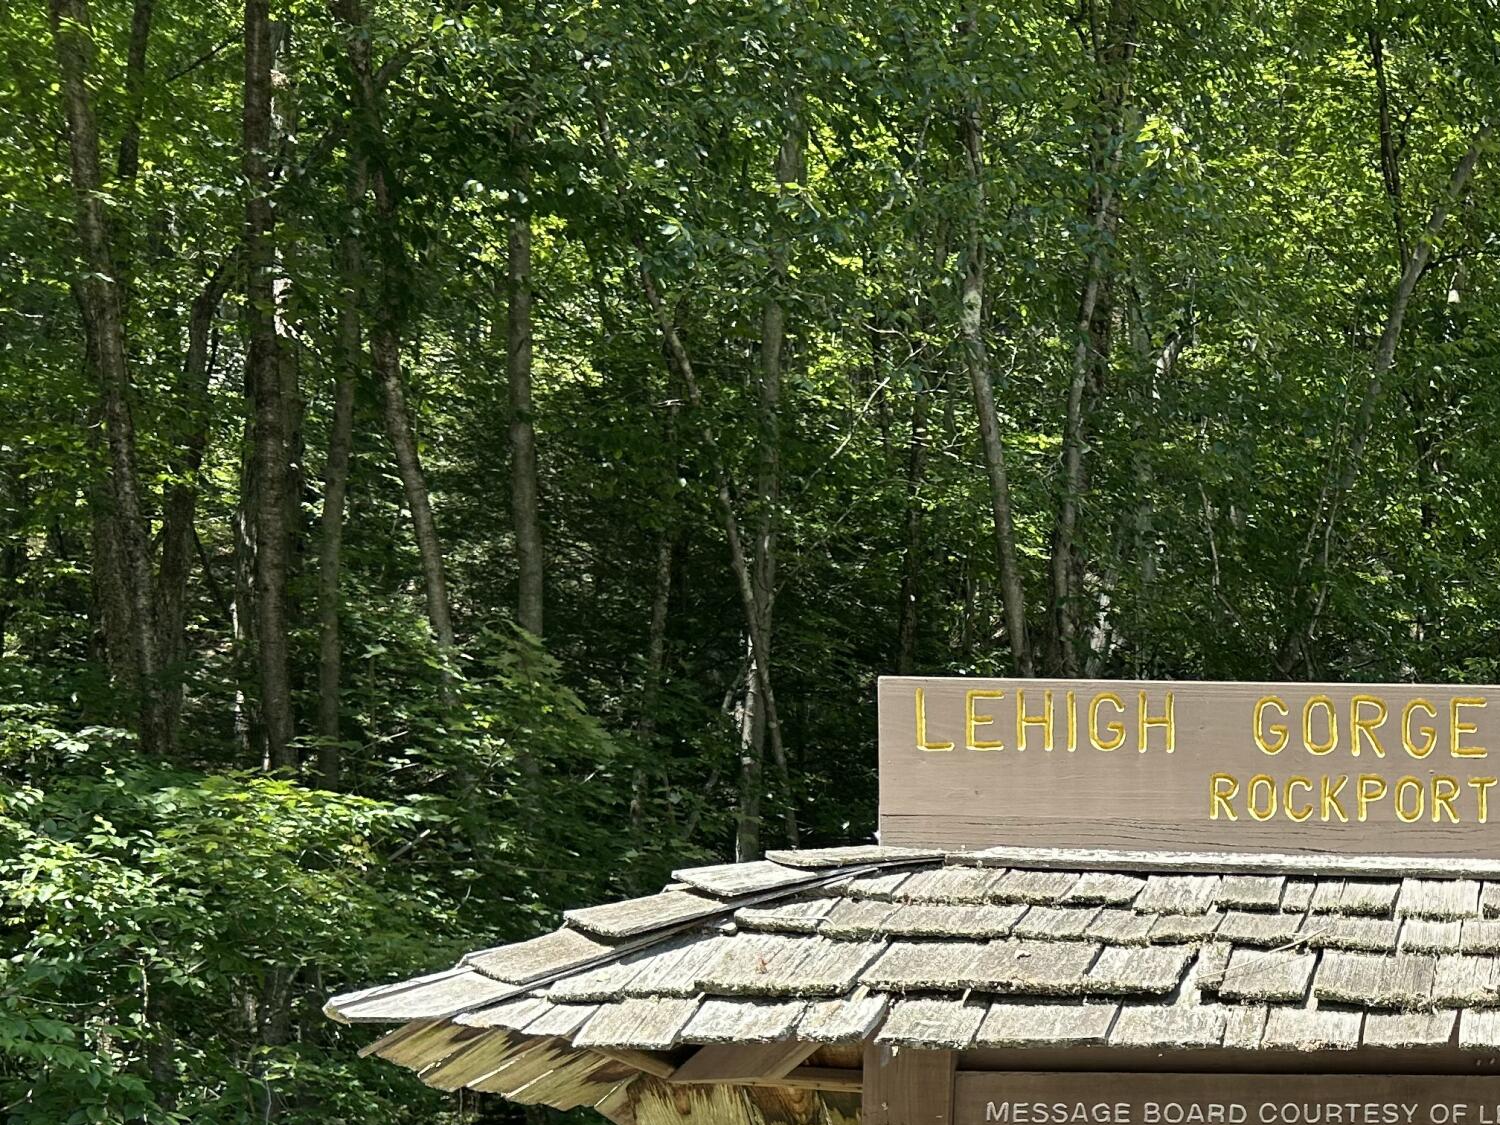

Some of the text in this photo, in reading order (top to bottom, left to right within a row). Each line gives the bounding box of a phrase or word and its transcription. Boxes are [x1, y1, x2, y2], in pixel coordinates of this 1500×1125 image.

[915, 688, 1176, 752] LEHIGH
[1252, 694, 1488, 758] GORGE
[1210, 772, 1496, 822] ROCKPORT
[986, 1102, 1130, 1122] MESSAGE
[1144, 1102, 1247, 1123] BOARD
[1259, 1103, 1418, 1123] COURTESY
[1430, 1104, 1467, 1124] OF
